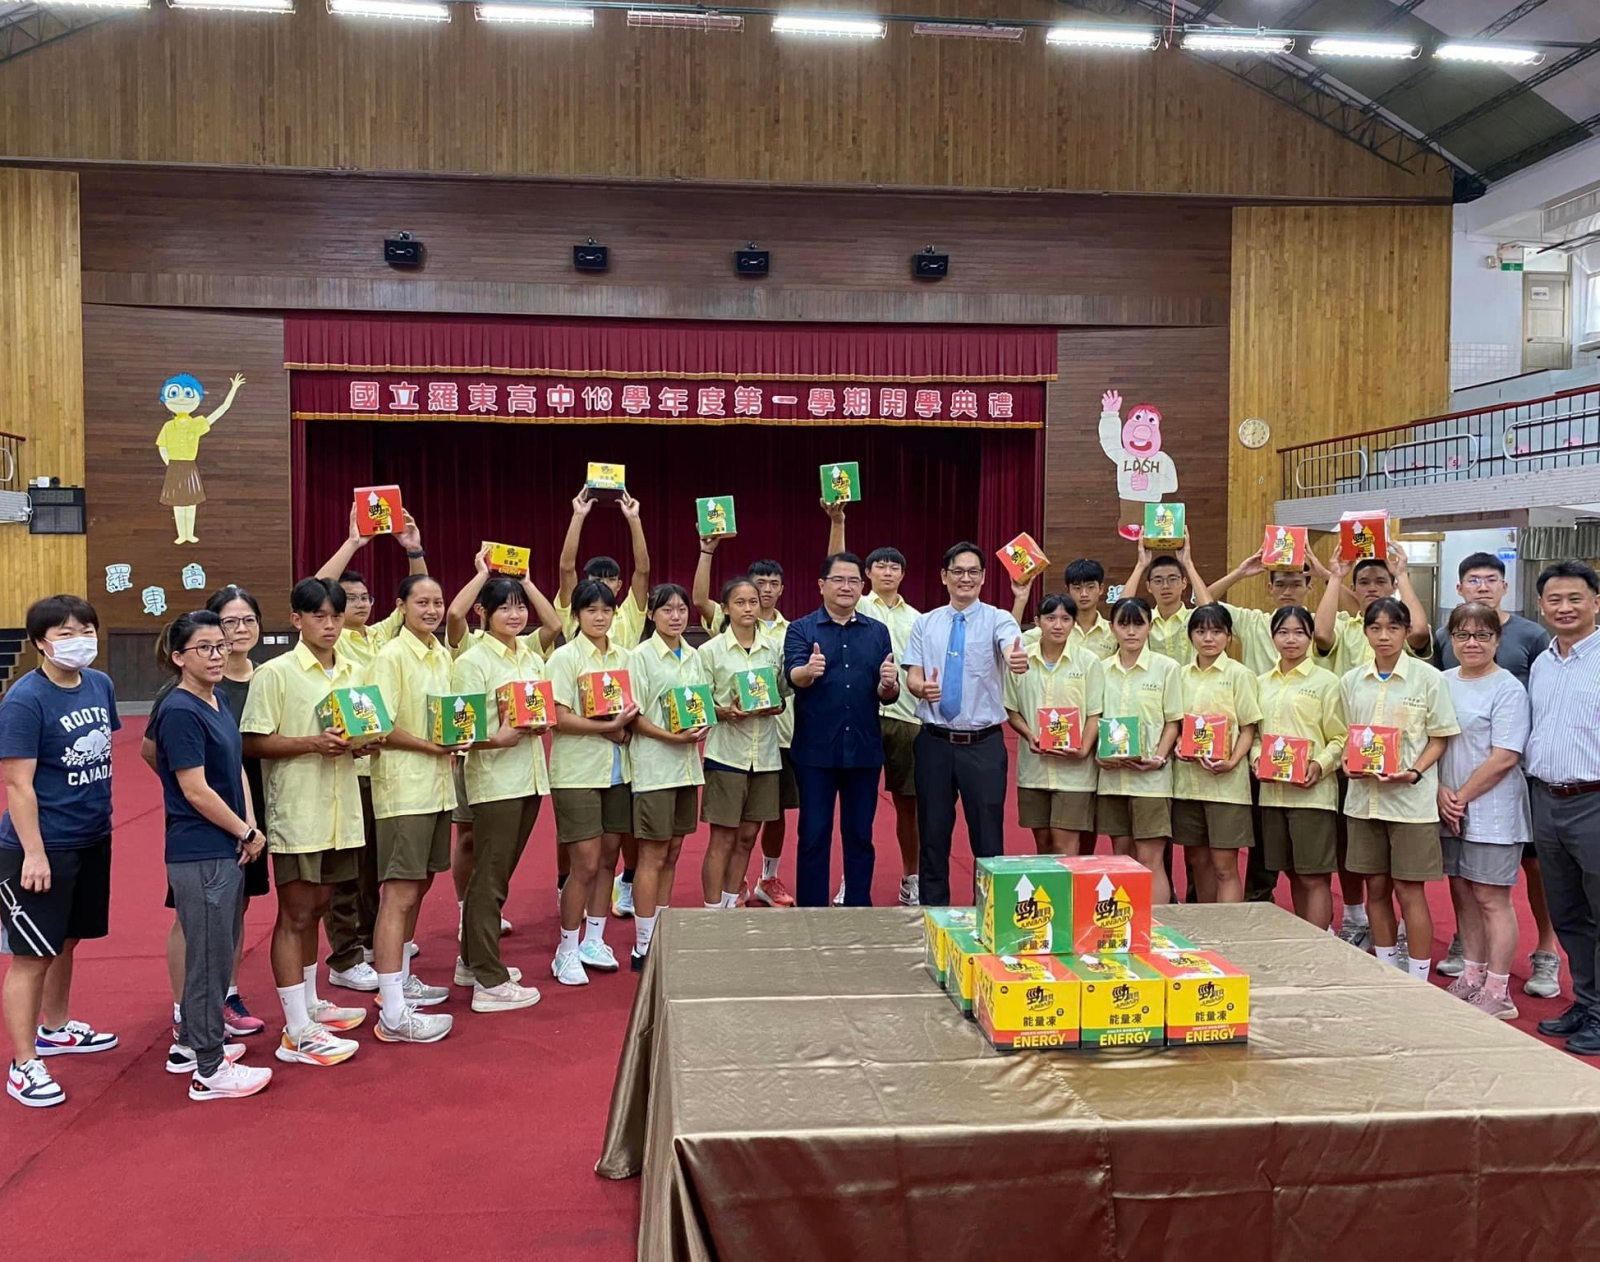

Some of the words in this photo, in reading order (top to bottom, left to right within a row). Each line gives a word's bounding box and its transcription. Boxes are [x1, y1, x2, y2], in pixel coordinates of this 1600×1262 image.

[349, 380, 1013, 419] 國立羅東高中113學年度第一學期開學典禮
[60, 706, 108, 733] ROOTS
[1023, 1015, 1057, 1027] 能量凍
[1109, 1013, 1142, 1025] 能量凍
[1195, 1010, 1227, 1022] 能量凍
[1013, 1033, 1066, 1048] ENERGY
[1099, 1030, 1151, 1046] ENERGY
[1185, 1027, 1236, 1043] ENERGY
